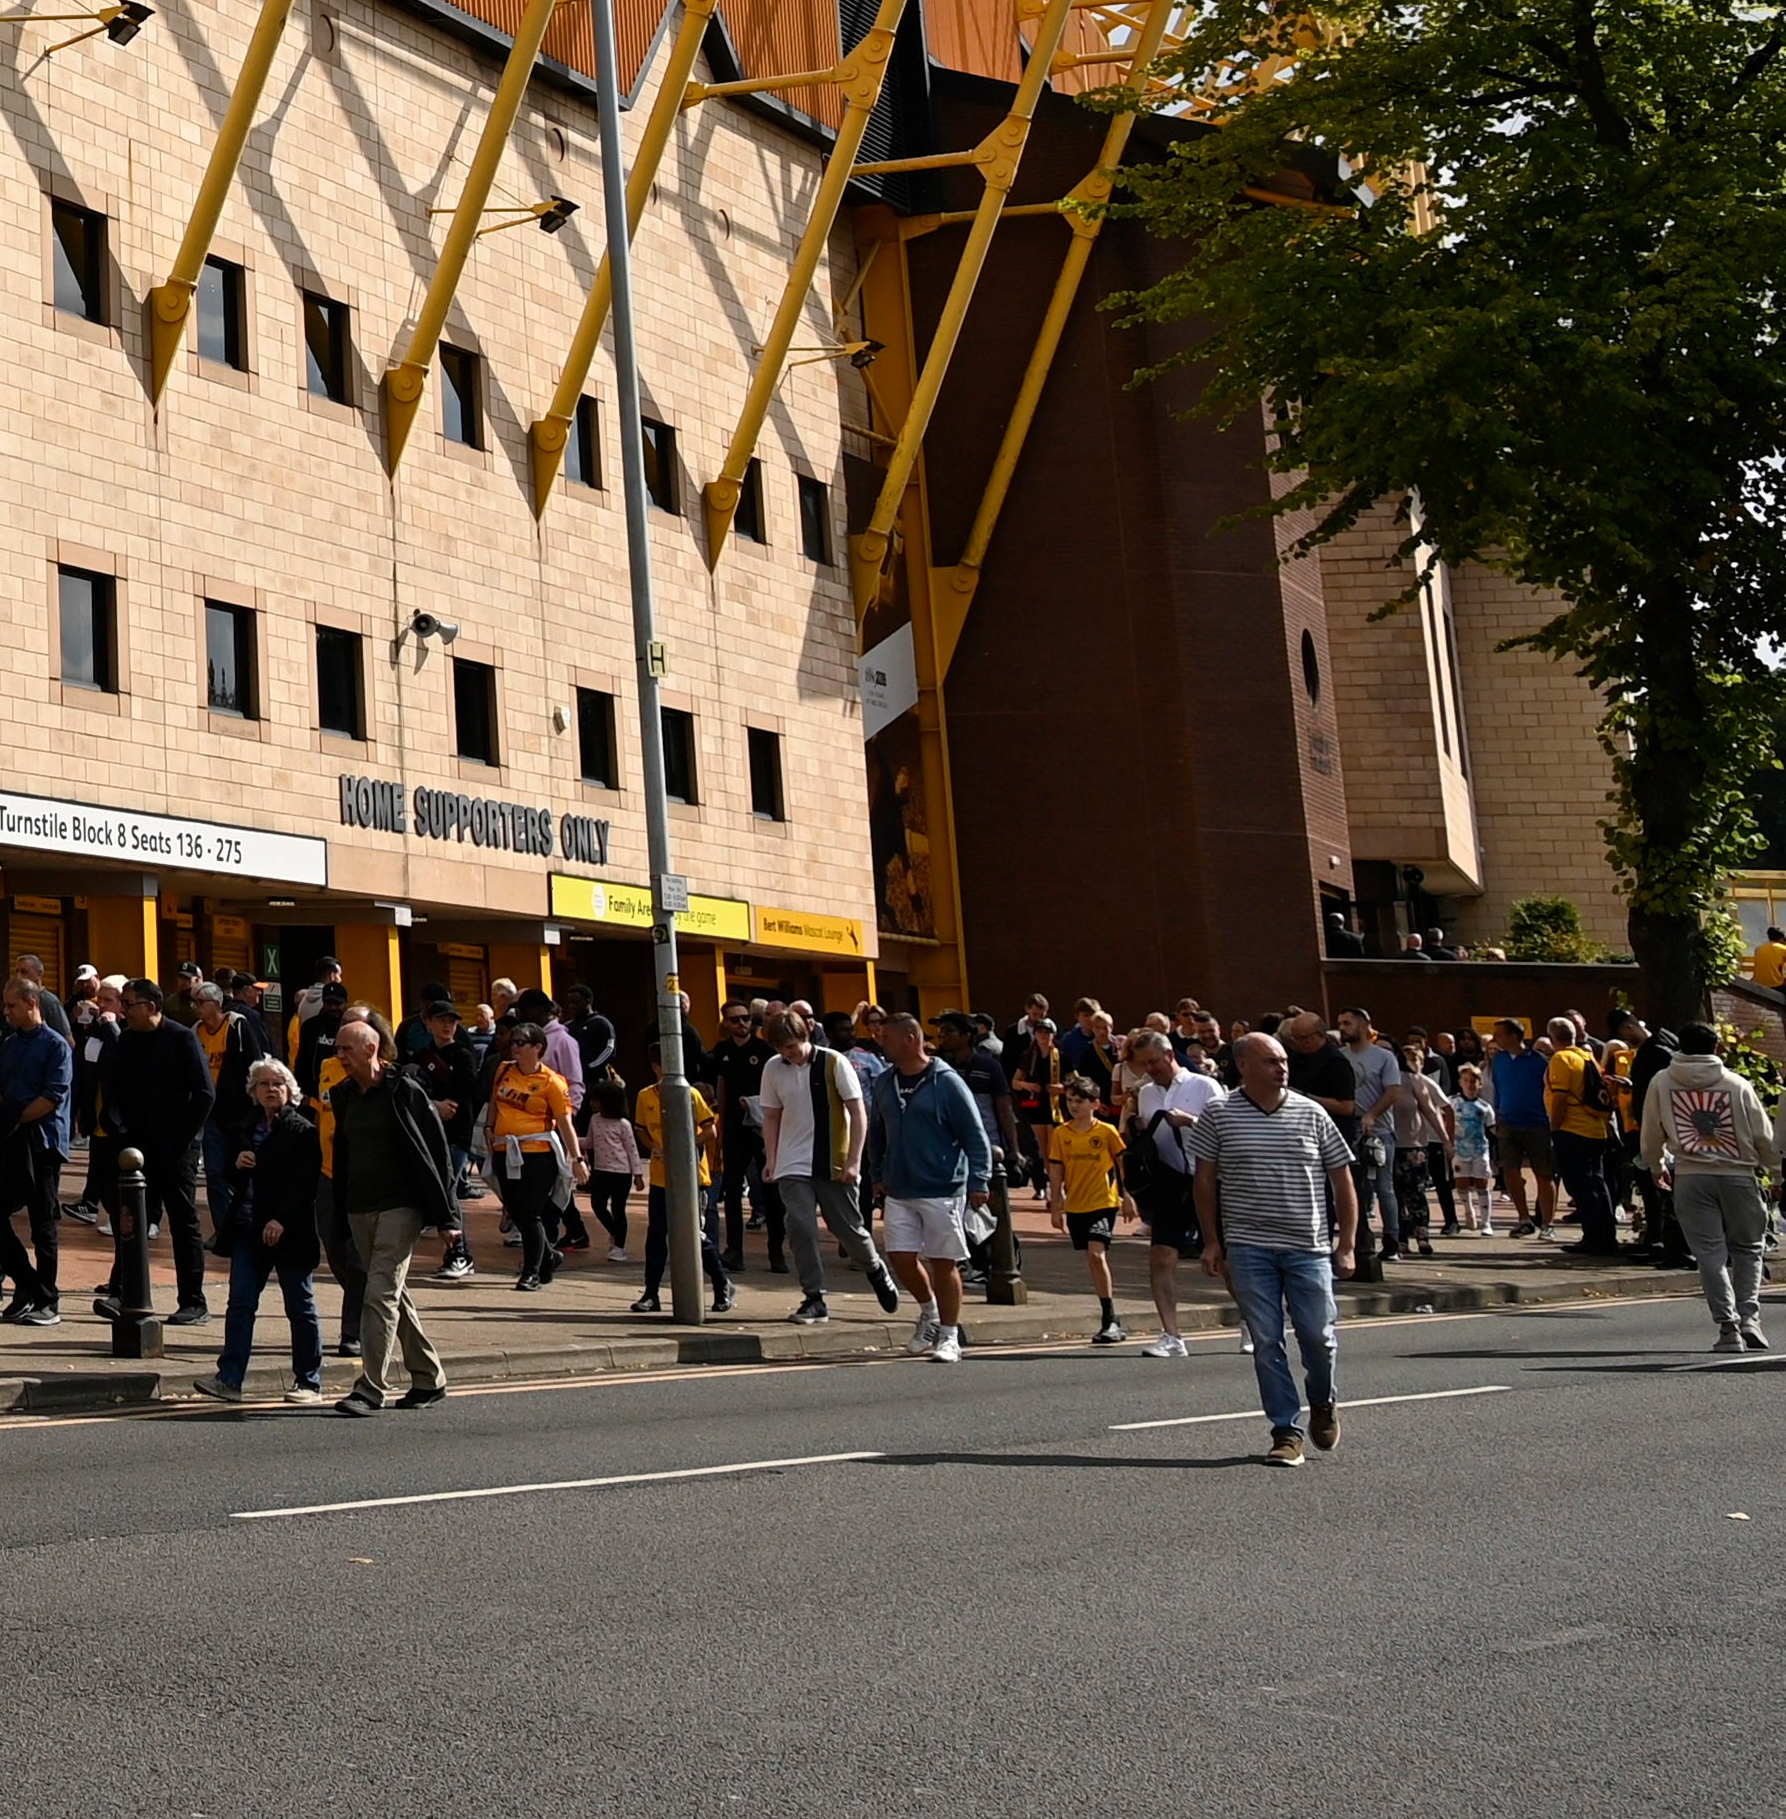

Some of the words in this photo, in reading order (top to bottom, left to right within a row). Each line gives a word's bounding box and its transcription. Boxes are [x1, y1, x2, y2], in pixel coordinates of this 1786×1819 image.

[339, 774, 406, 834] HOME
[413, 785, 553, 857] SUPPORTERS
[560, 812, 610, 865] ONLY
[72, 816, 113, 846] Block
[117, 823, 127, 847] 8
[131, 825, 172, 855] Seats
[176, 832, 203, 859] 136
[216, 838, 243, 865] 275
[609, 895, 636, 918] Family
[637, 899, 652, 917] Are
[763, 917, 776, 933] Bert
[777, 920, 803, 936] Williams
